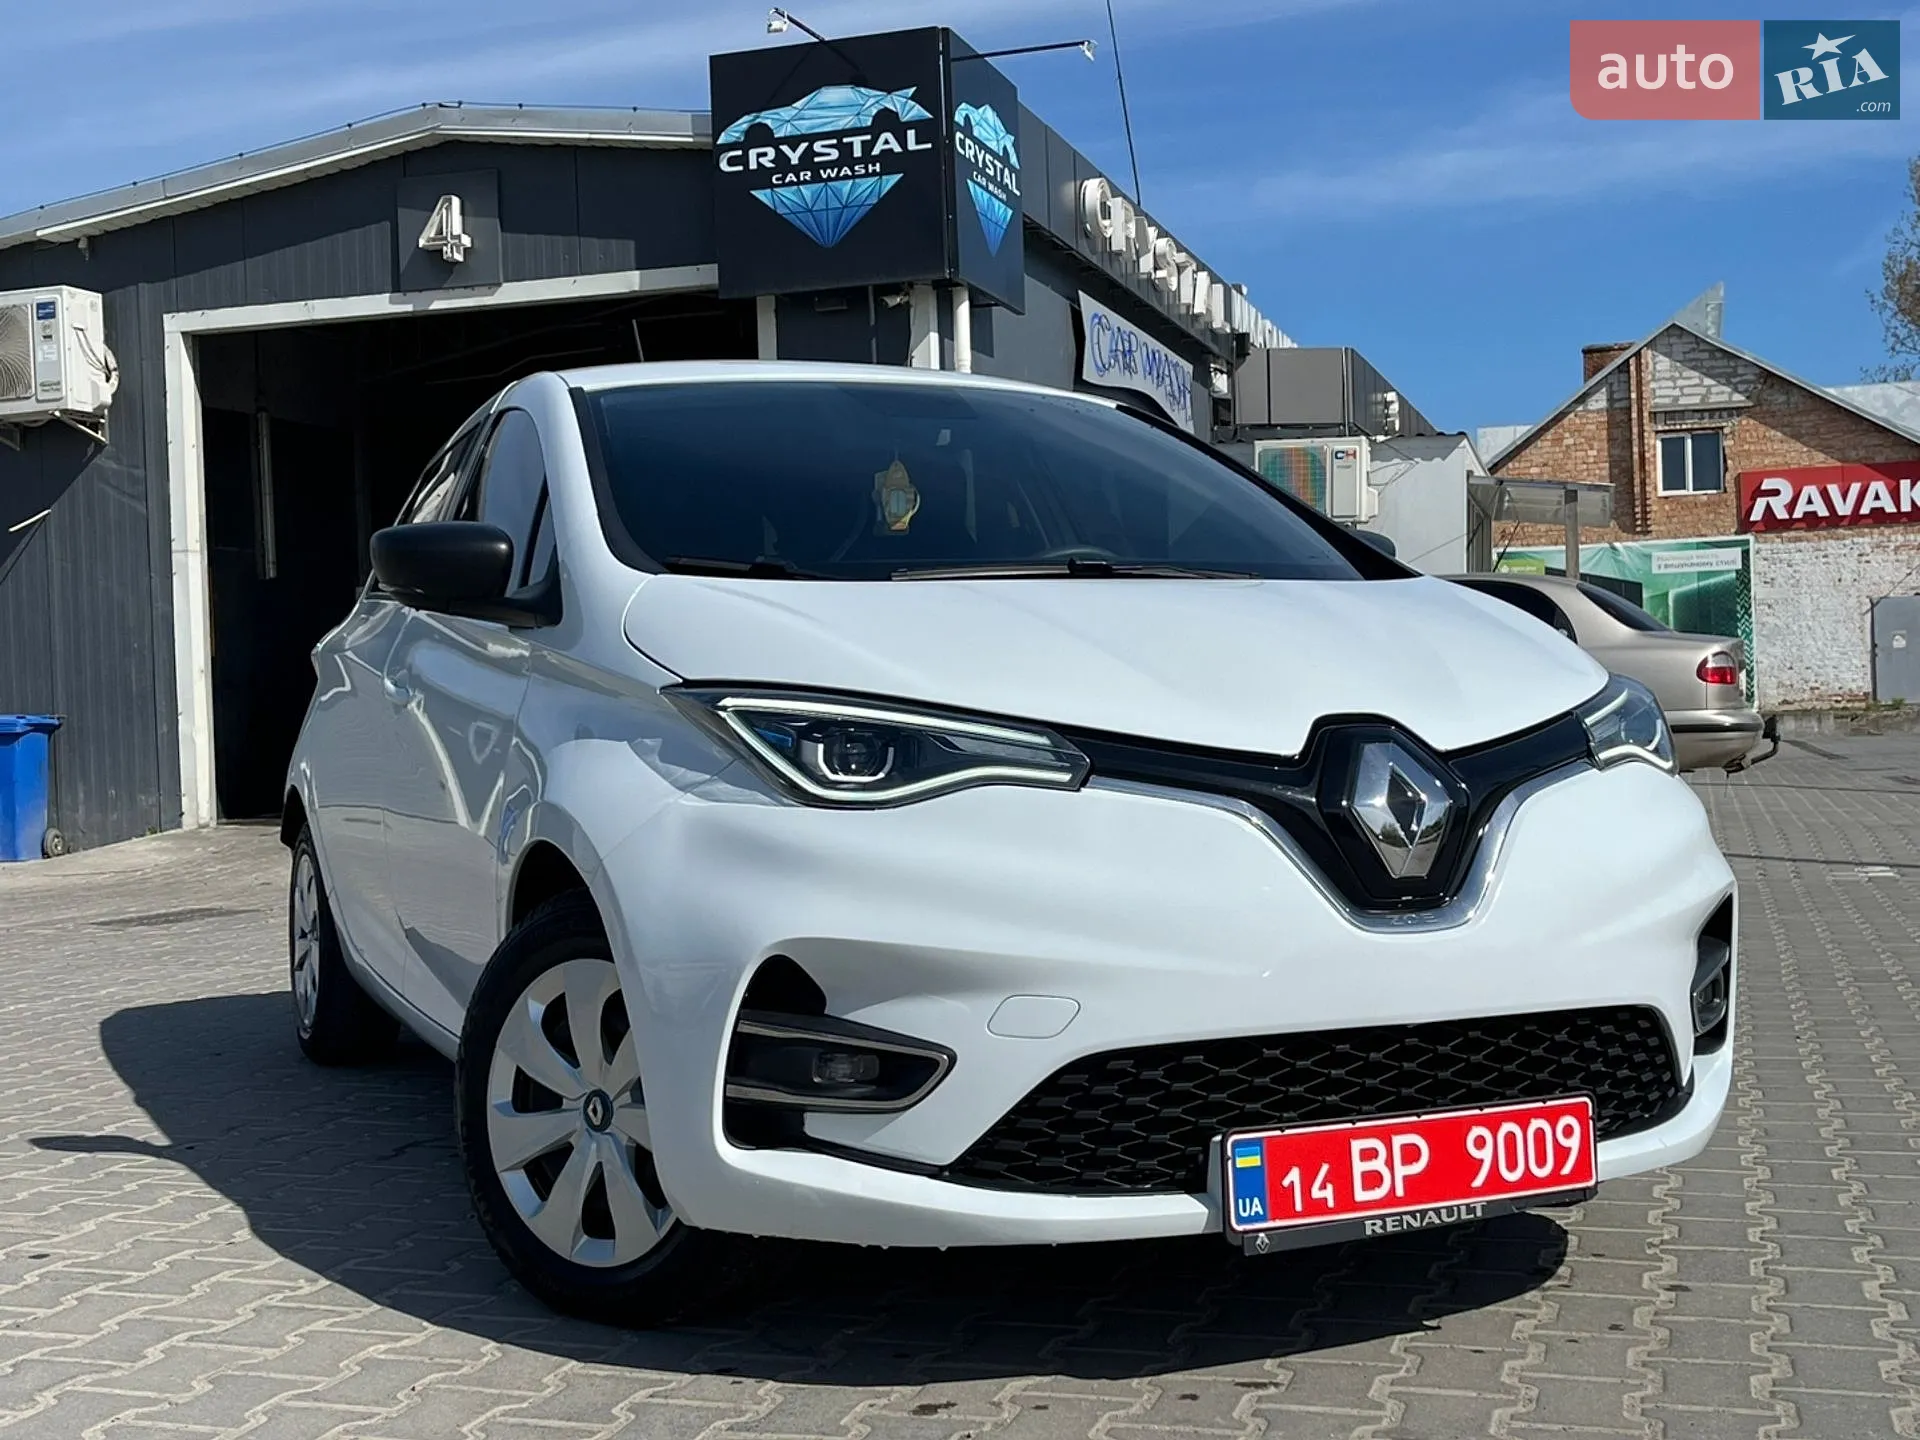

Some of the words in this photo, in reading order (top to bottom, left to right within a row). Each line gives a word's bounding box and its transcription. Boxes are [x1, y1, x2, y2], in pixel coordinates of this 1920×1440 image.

[718, 129, 933, 173] CRYSTAL
[955, 131, 1021, 197] CRYSTAL
[771, 170, 812, 185] CAR
[819, 162, 882, 180] WASH
[973, 171, 987, 188] CAR
[419, 194, 472, 262] 4
[1750, 477, 1920, 521] RAVAK
[1239, 1197, 1264, 1218] UA
[1282, 1163, 1335, 1213] 14
[1350, 1133, 1430, 1203] BP
[1466, 1115, 1582, 1189] 9009
[1365, 1202, 1488, 1237] RENAULT
